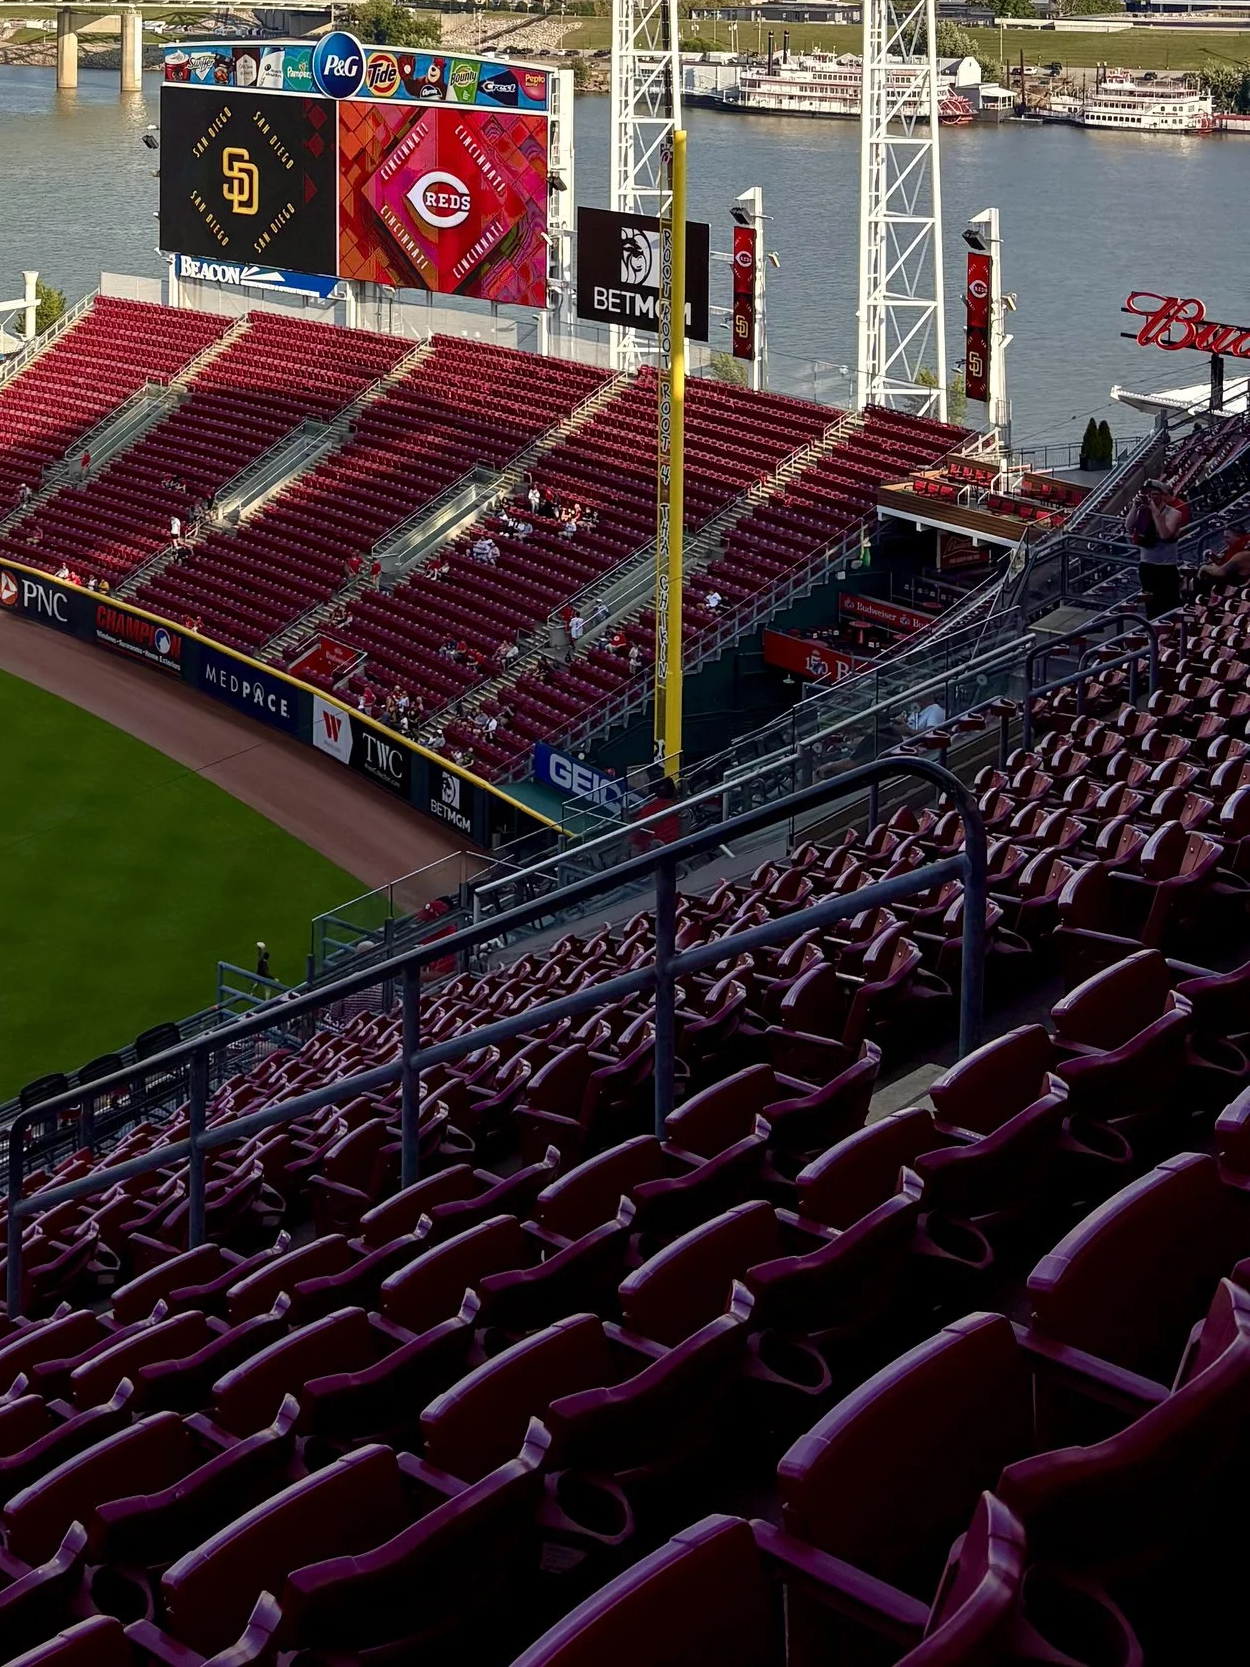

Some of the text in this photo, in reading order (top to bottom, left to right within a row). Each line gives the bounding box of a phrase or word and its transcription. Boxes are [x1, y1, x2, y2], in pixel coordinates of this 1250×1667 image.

[323, 54, 359, 78] P&G
[368, 62, 397, 89] Tide
[450, 71, 478, 86] Bounty
[482, 81, 516, 94] Crest
[525, 73, 546, 84] Pepto
[192, 106, 232, 158] SAN DIEGO
[252, 111, 295, 170] SAN DIEGO
[381, 122, 429, 180] CINCINNATI
[455, 125, 506, 193] CINCINNATI
[190, 190, 230, 247] SAN DIEGO
[425, 191, 471, 211] REDS
[254, 203, 296, 254] SAN DIEGO
[381, 205, 428, 270] CINCINNATI
[453, 221, 504, 279] CINCINNATI
[180, 255, 241, 285] BEACON
[660, 383, 671, 453] ROOT
[660, 465, 671, 486] 4
[659, 503, 670, 556] THA
[21, 579, 68, 622] PNC
[856, 601, 897, 622] Budweiser
[657, 573, 669, 680] CHIKIN
[206, 663, 288, 718] MEDPACE
[362, 732, 403, 778] TWC
[430, 798, 471, 833] BETMGM
